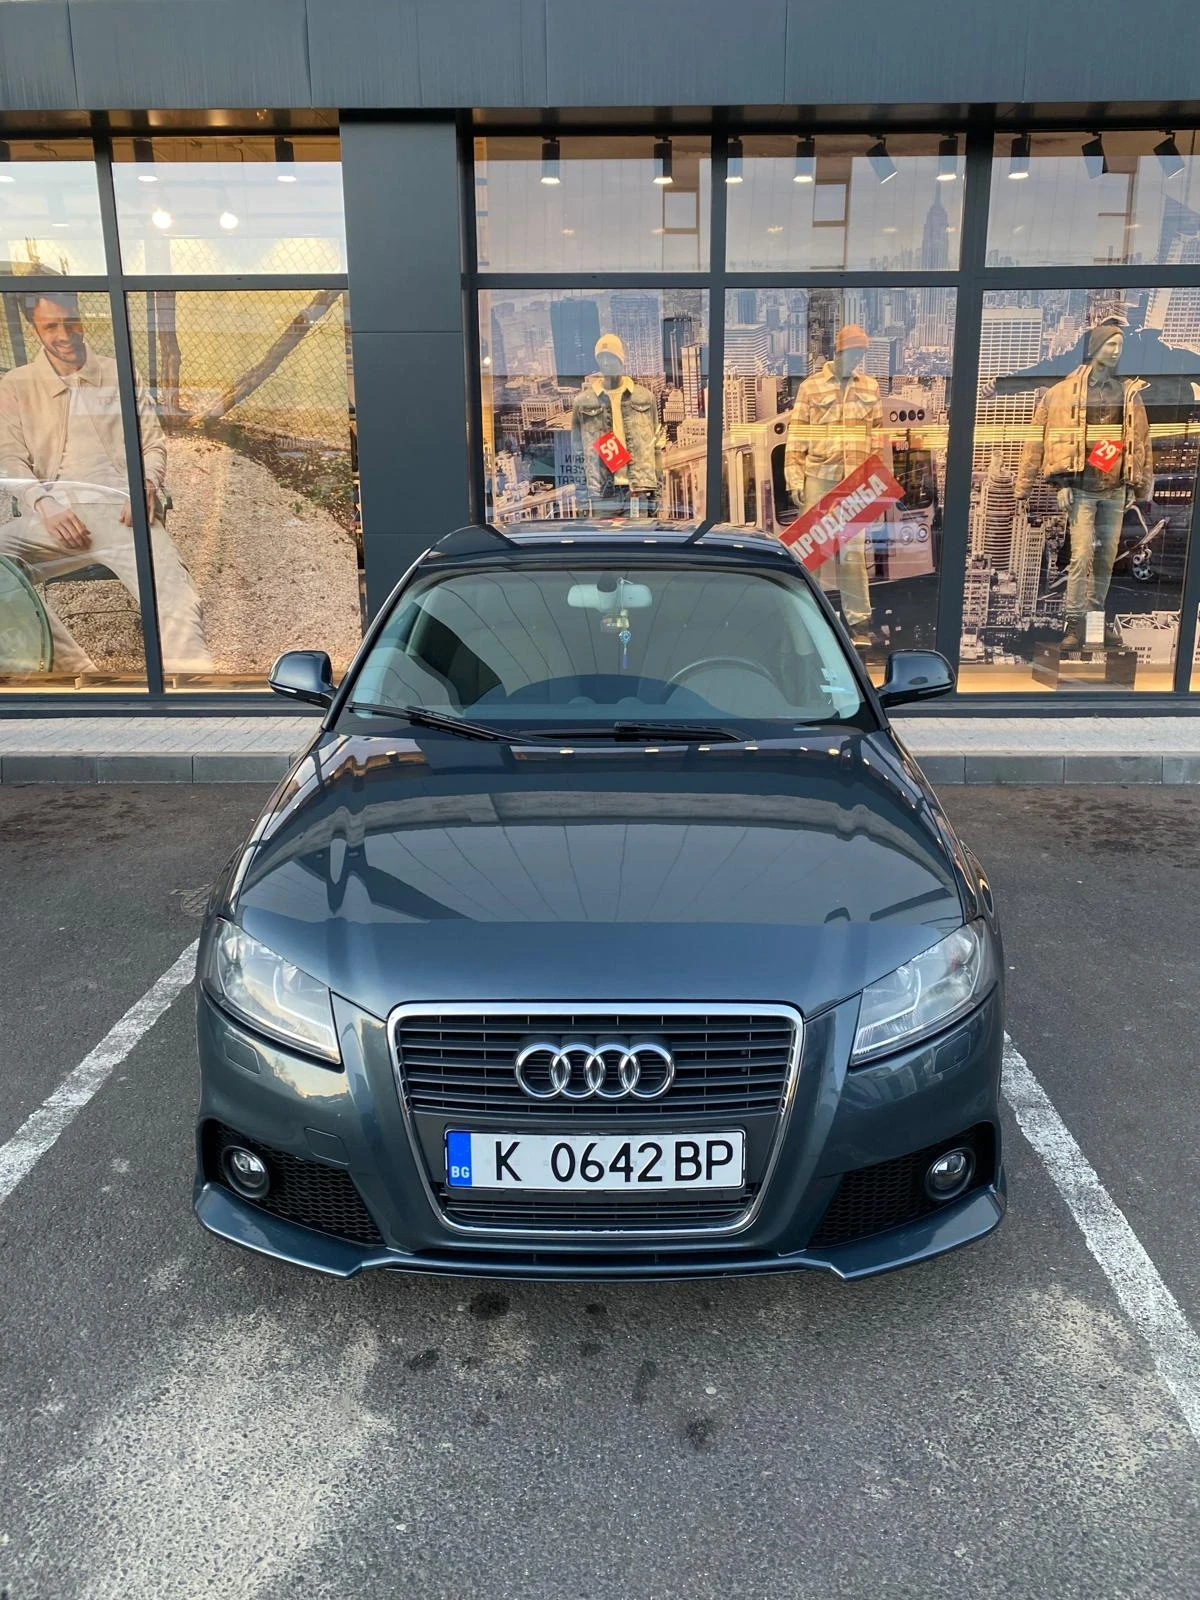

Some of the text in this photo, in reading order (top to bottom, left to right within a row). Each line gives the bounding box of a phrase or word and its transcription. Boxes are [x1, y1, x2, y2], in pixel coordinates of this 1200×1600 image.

[788, 473, 889, 562] ПРОДАЖБА
[451, 1166, 470, 1178] BG
[495, 1139, 733, 1182] K 0642 BP
